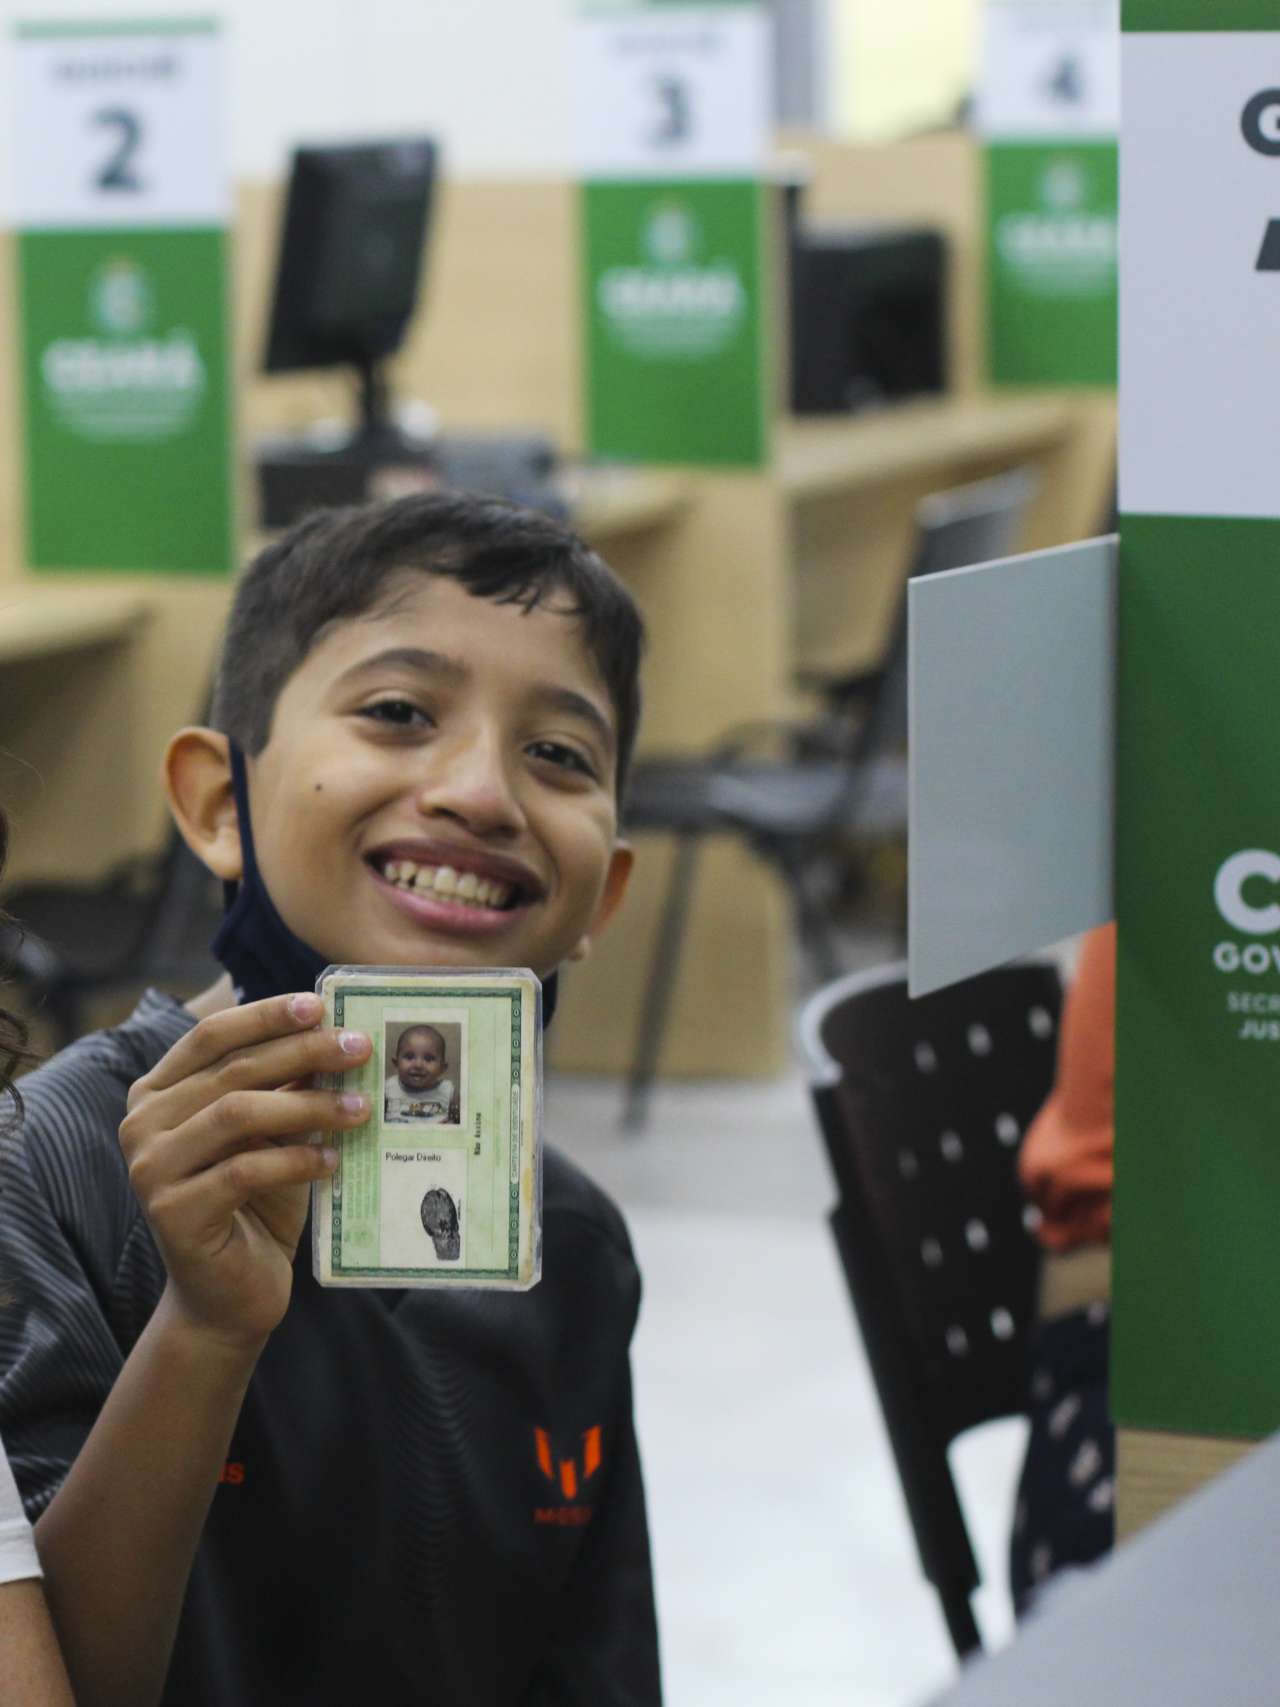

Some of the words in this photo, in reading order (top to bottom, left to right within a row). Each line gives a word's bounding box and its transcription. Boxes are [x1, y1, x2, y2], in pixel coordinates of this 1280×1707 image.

[89, 107, 147, 192] 2
[385, 1151, 414, 1162] Polegar
[416, 1152, 441, 1162] Direito
